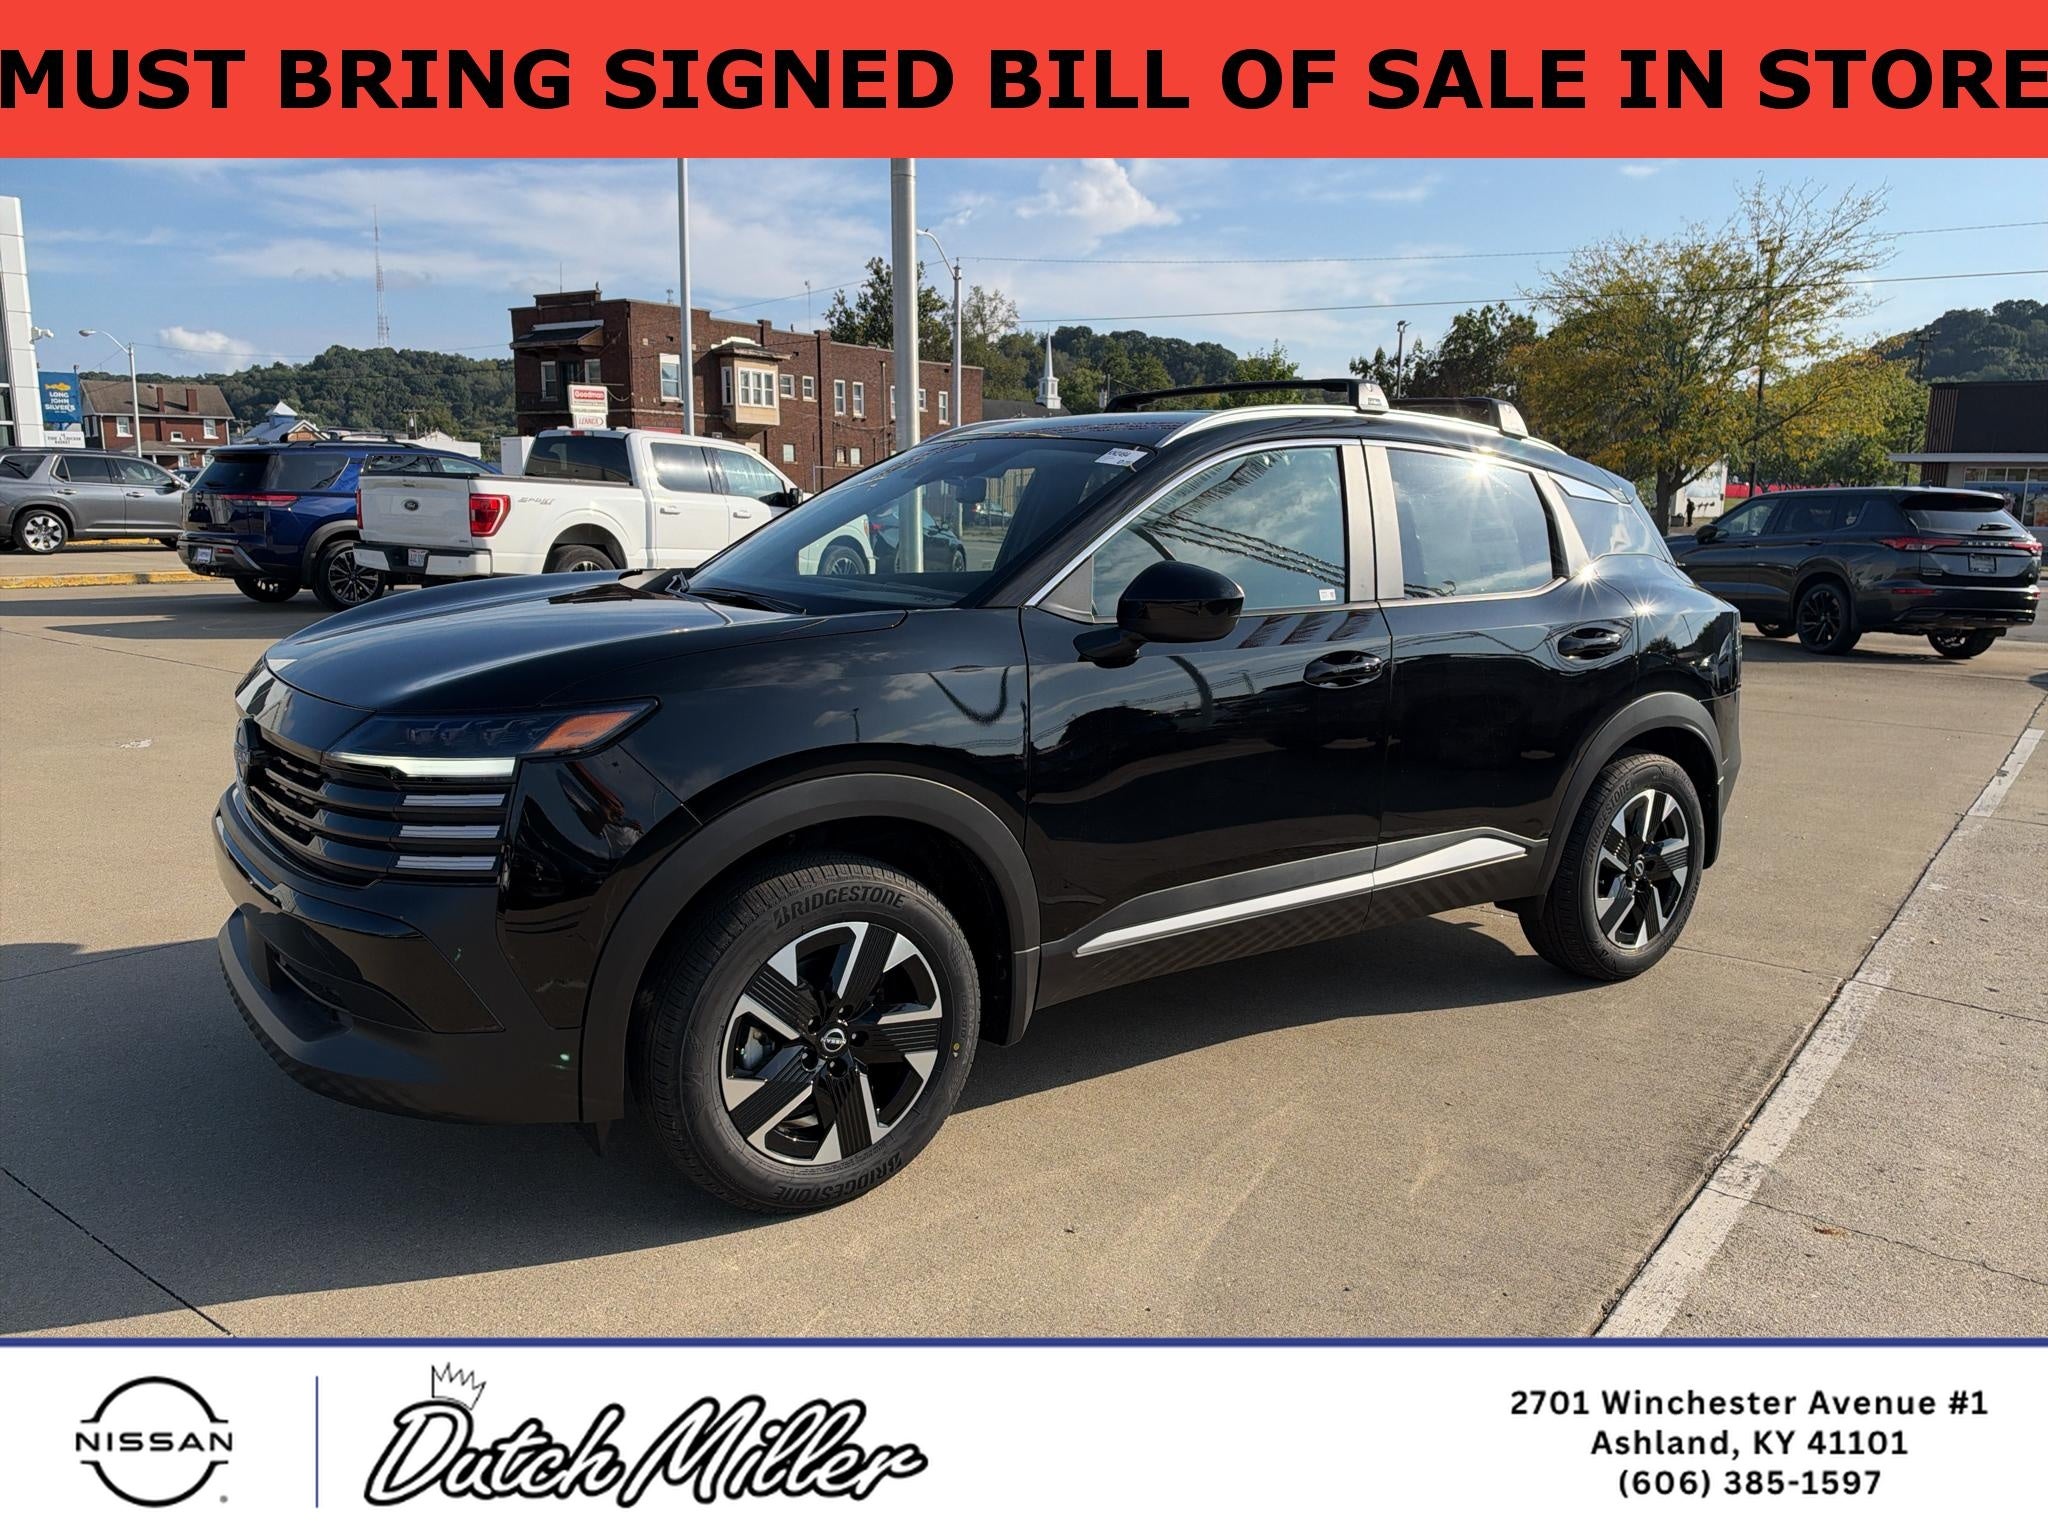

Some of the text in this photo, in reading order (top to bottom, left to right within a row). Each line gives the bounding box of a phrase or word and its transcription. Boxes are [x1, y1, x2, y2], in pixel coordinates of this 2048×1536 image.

[574, 390, 604, 399] Goodman
[772, 885, 906, 930] BRIDGESTONE
[773, 1151, 902, 1202] BRIDGESTONE
